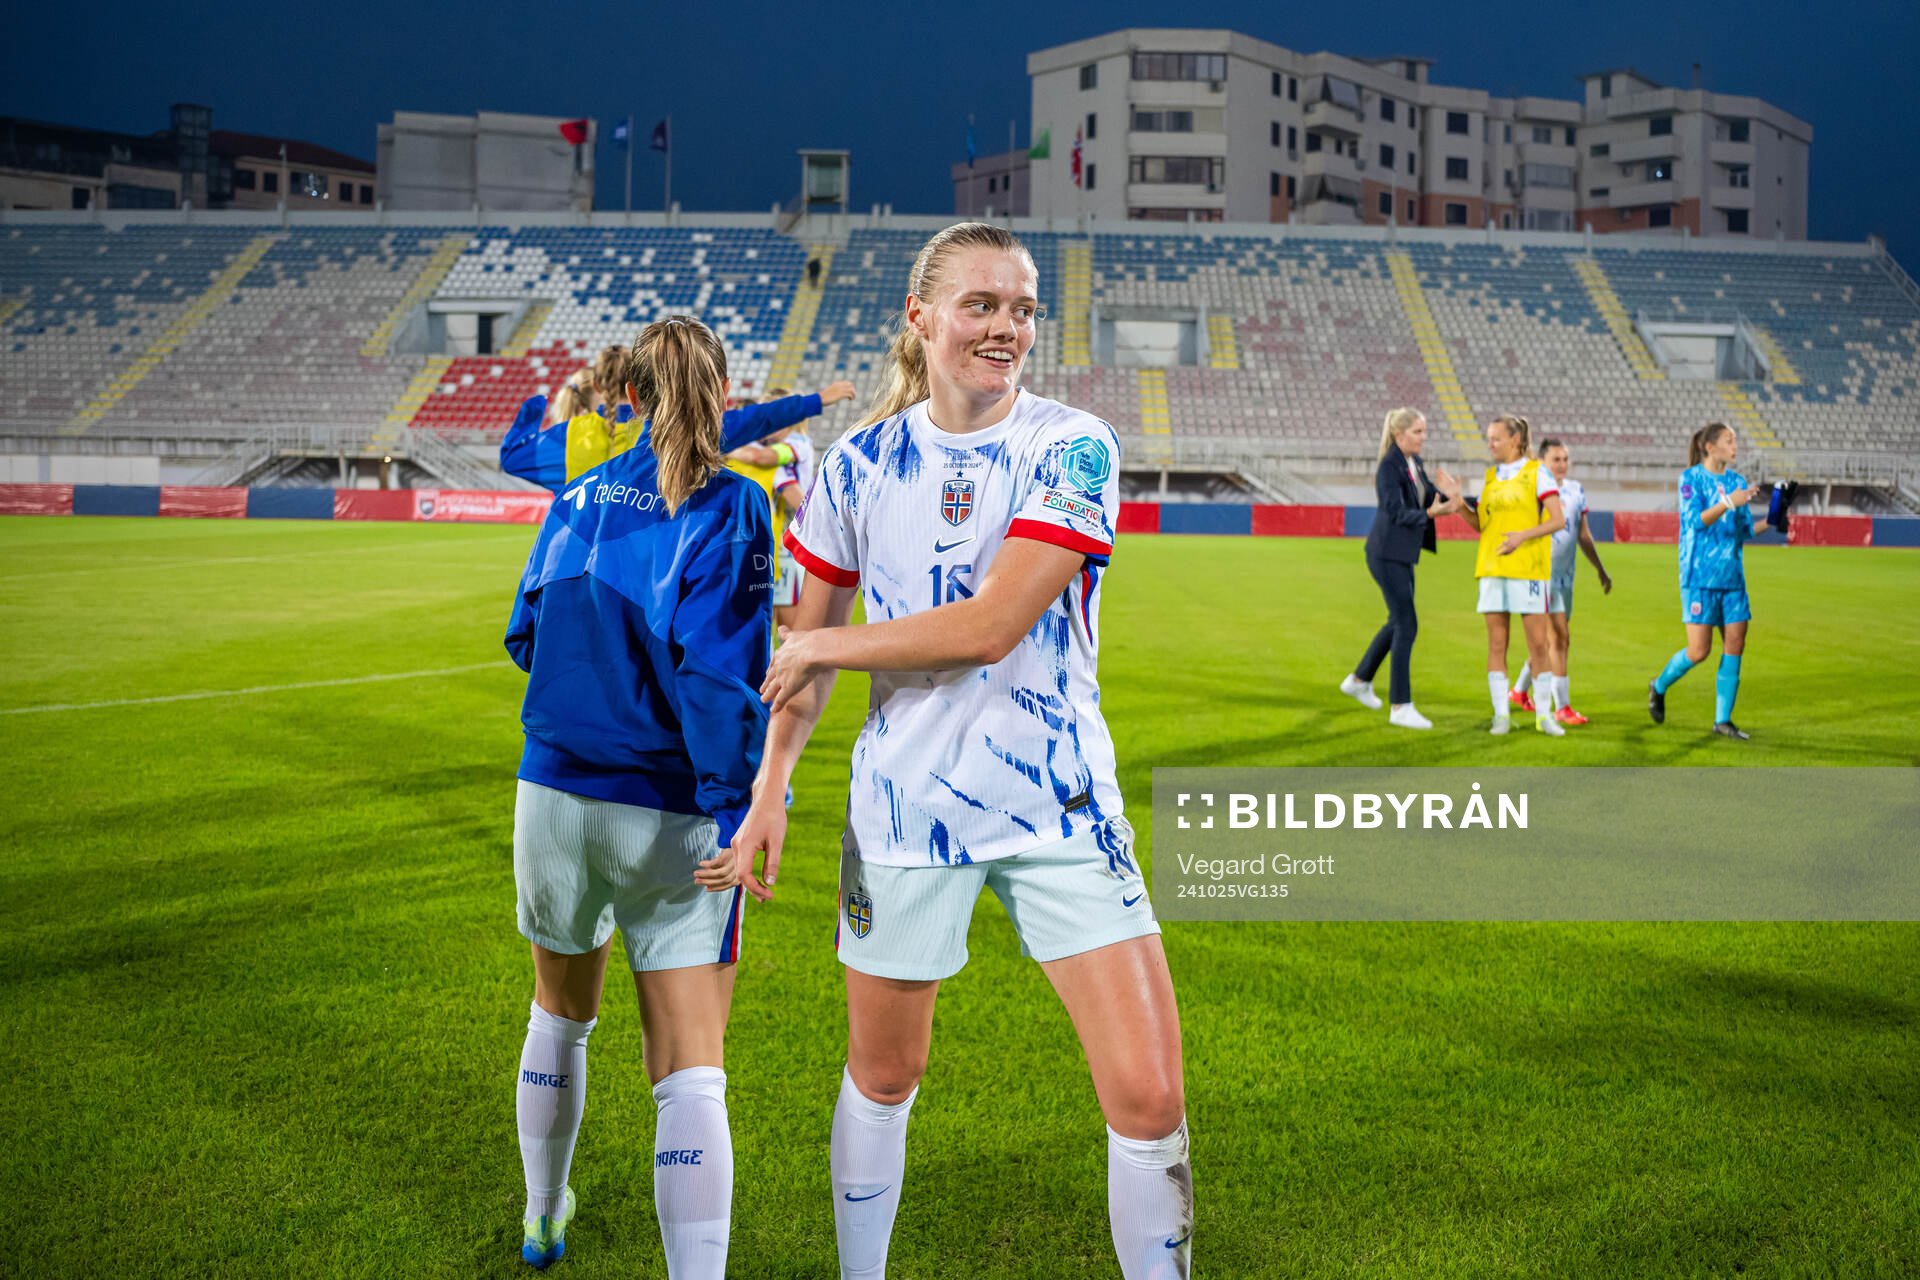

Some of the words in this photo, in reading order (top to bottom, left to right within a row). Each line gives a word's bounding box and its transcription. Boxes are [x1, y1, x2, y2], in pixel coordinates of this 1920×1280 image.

[593, 480, 662, 513] telenor
[1045, 489, 1063, 499] UEFA
[1043, 495, 1101, 523] FOUNDATIO
[522, 1069, 569, 1089] NORGE
[655, 1149, 704, 1169] NORGE
